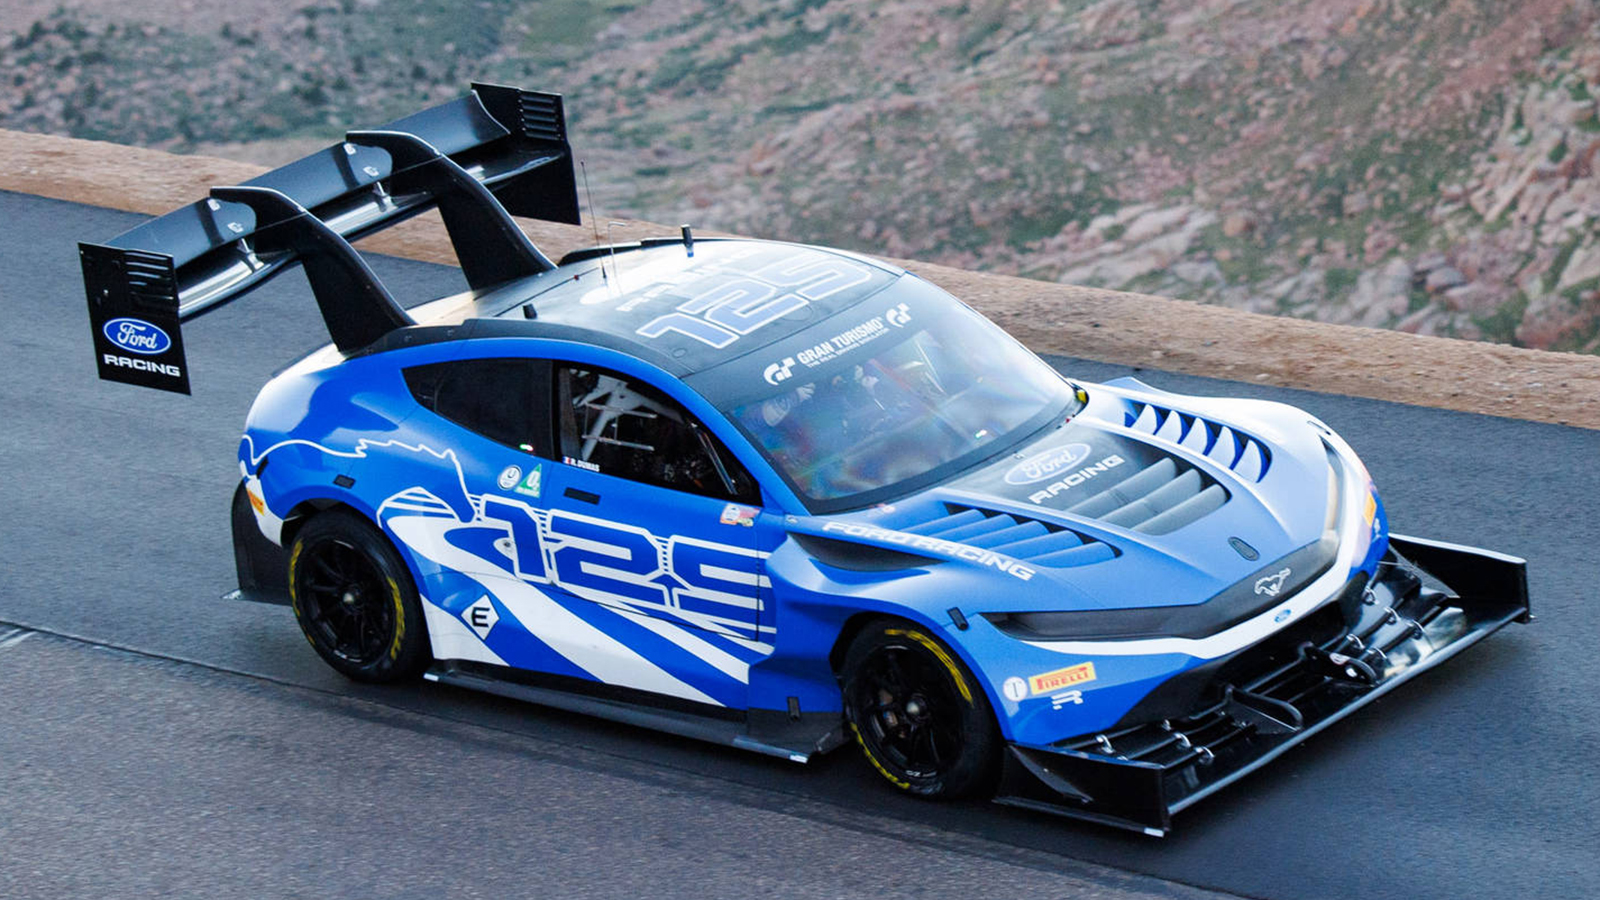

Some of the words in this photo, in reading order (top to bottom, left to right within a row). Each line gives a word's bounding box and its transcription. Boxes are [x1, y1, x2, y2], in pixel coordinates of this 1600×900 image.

[636, 252, 873, 349] 125
[117, 322, 158, 349] Ford
[796, 341, 835, 365] GRAN
[830, 317, 884, 348] TURISMO
[103, 353, 181, 377] RACING
[1022, 450, 1077, 479] Ford
[1028, 454, 1125, 504] RACING
[481, 493, 778, 635] 125
[822, 521, 912, 548] FORD
[911, 532, 1036, 581] RACING
[471, 606, 491, 628] E
[1036, 666, 1090, 690] PIRELLI
